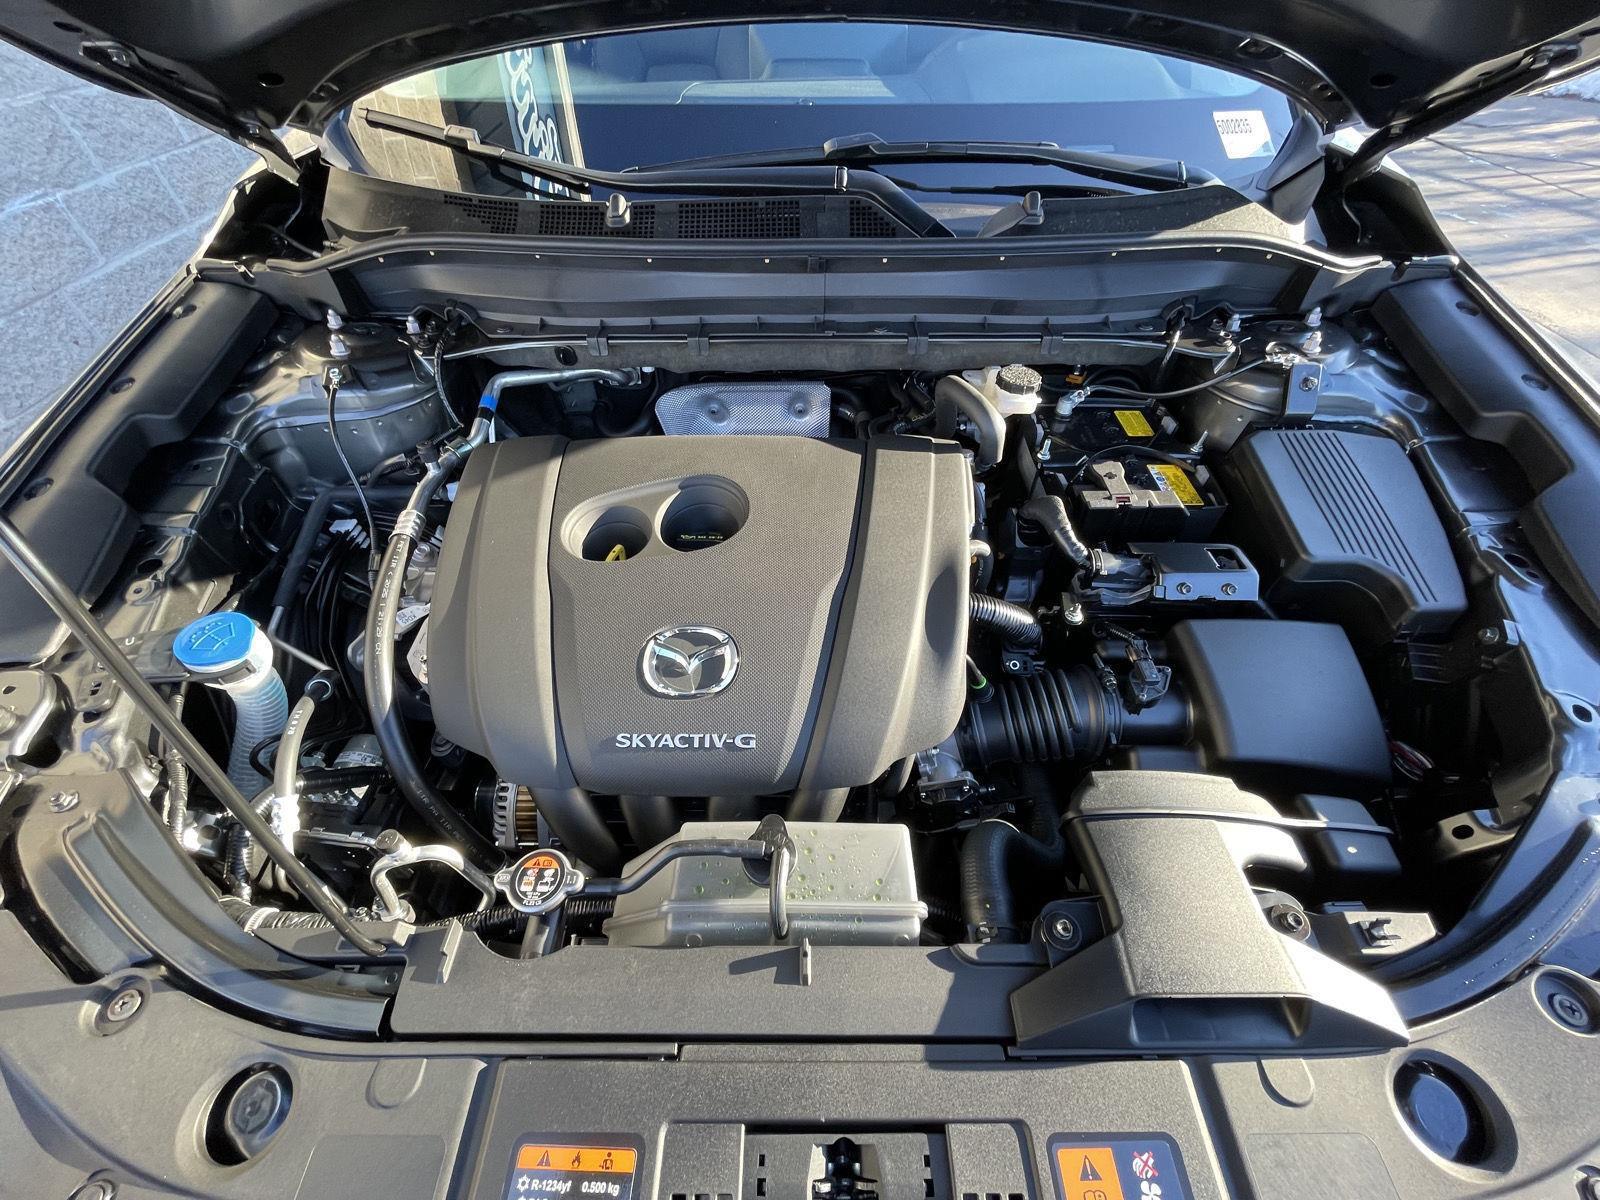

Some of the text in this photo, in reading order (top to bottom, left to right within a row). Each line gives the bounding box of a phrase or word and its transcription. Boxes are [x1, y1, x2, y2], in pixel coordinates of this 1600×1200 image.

[615, 733, 756, 749] SKYACTIV-G
[531, 1179, 620, 1196] R-1234yf 0.500 kg
